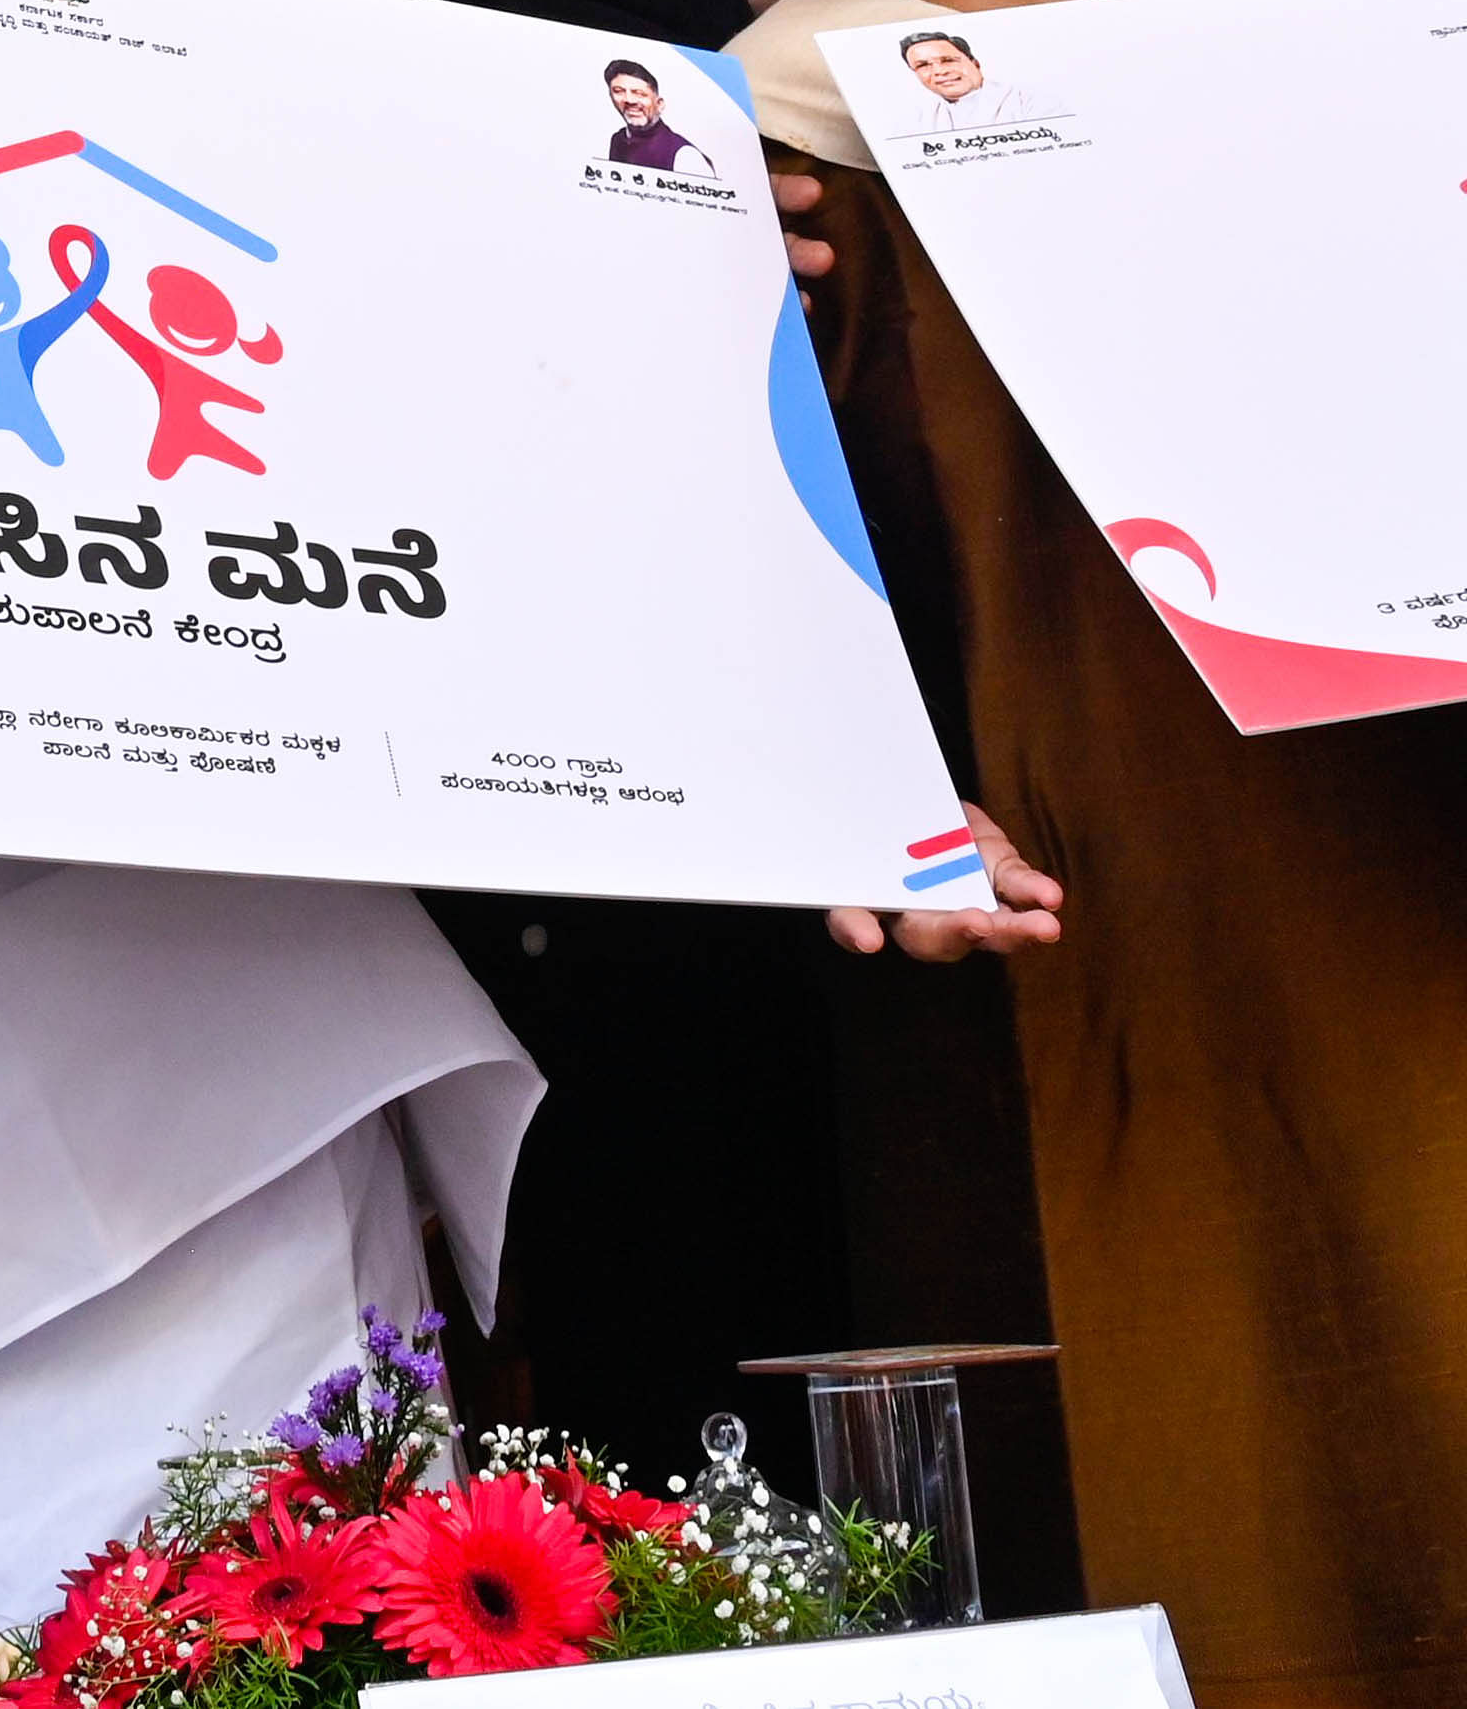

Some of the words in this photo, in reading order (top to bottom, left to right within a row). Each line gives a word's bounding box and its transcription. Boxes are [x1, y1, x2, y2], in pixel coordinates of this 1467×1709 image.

[204, 520, 447, 620] ಮನೆ
[173, 614, 287, 664] ಕೇಂದ್ರ
[28, 709, 104, 732] ನರೇಗಾ
[114, 717, 271, 747] ಕೂಲಿಕಾರ್ಮಿಕರ
[281, 732, 341, 760] ಮಕ್ಕಳ
[42, 741, 111, 760] ಪಾಲನೆ
[122, 745, 179, 773] ಮತ್ತು
[490, 751, 556, 770] 4000
[566, 757, 623, 779] ಗ್ರಾಮ
[440, 772, 609, 806] ಪಂಚಾಯತಿಗಳಲ್ಲಿ
[618, 785, 685, 806] ಆರಂಭ
